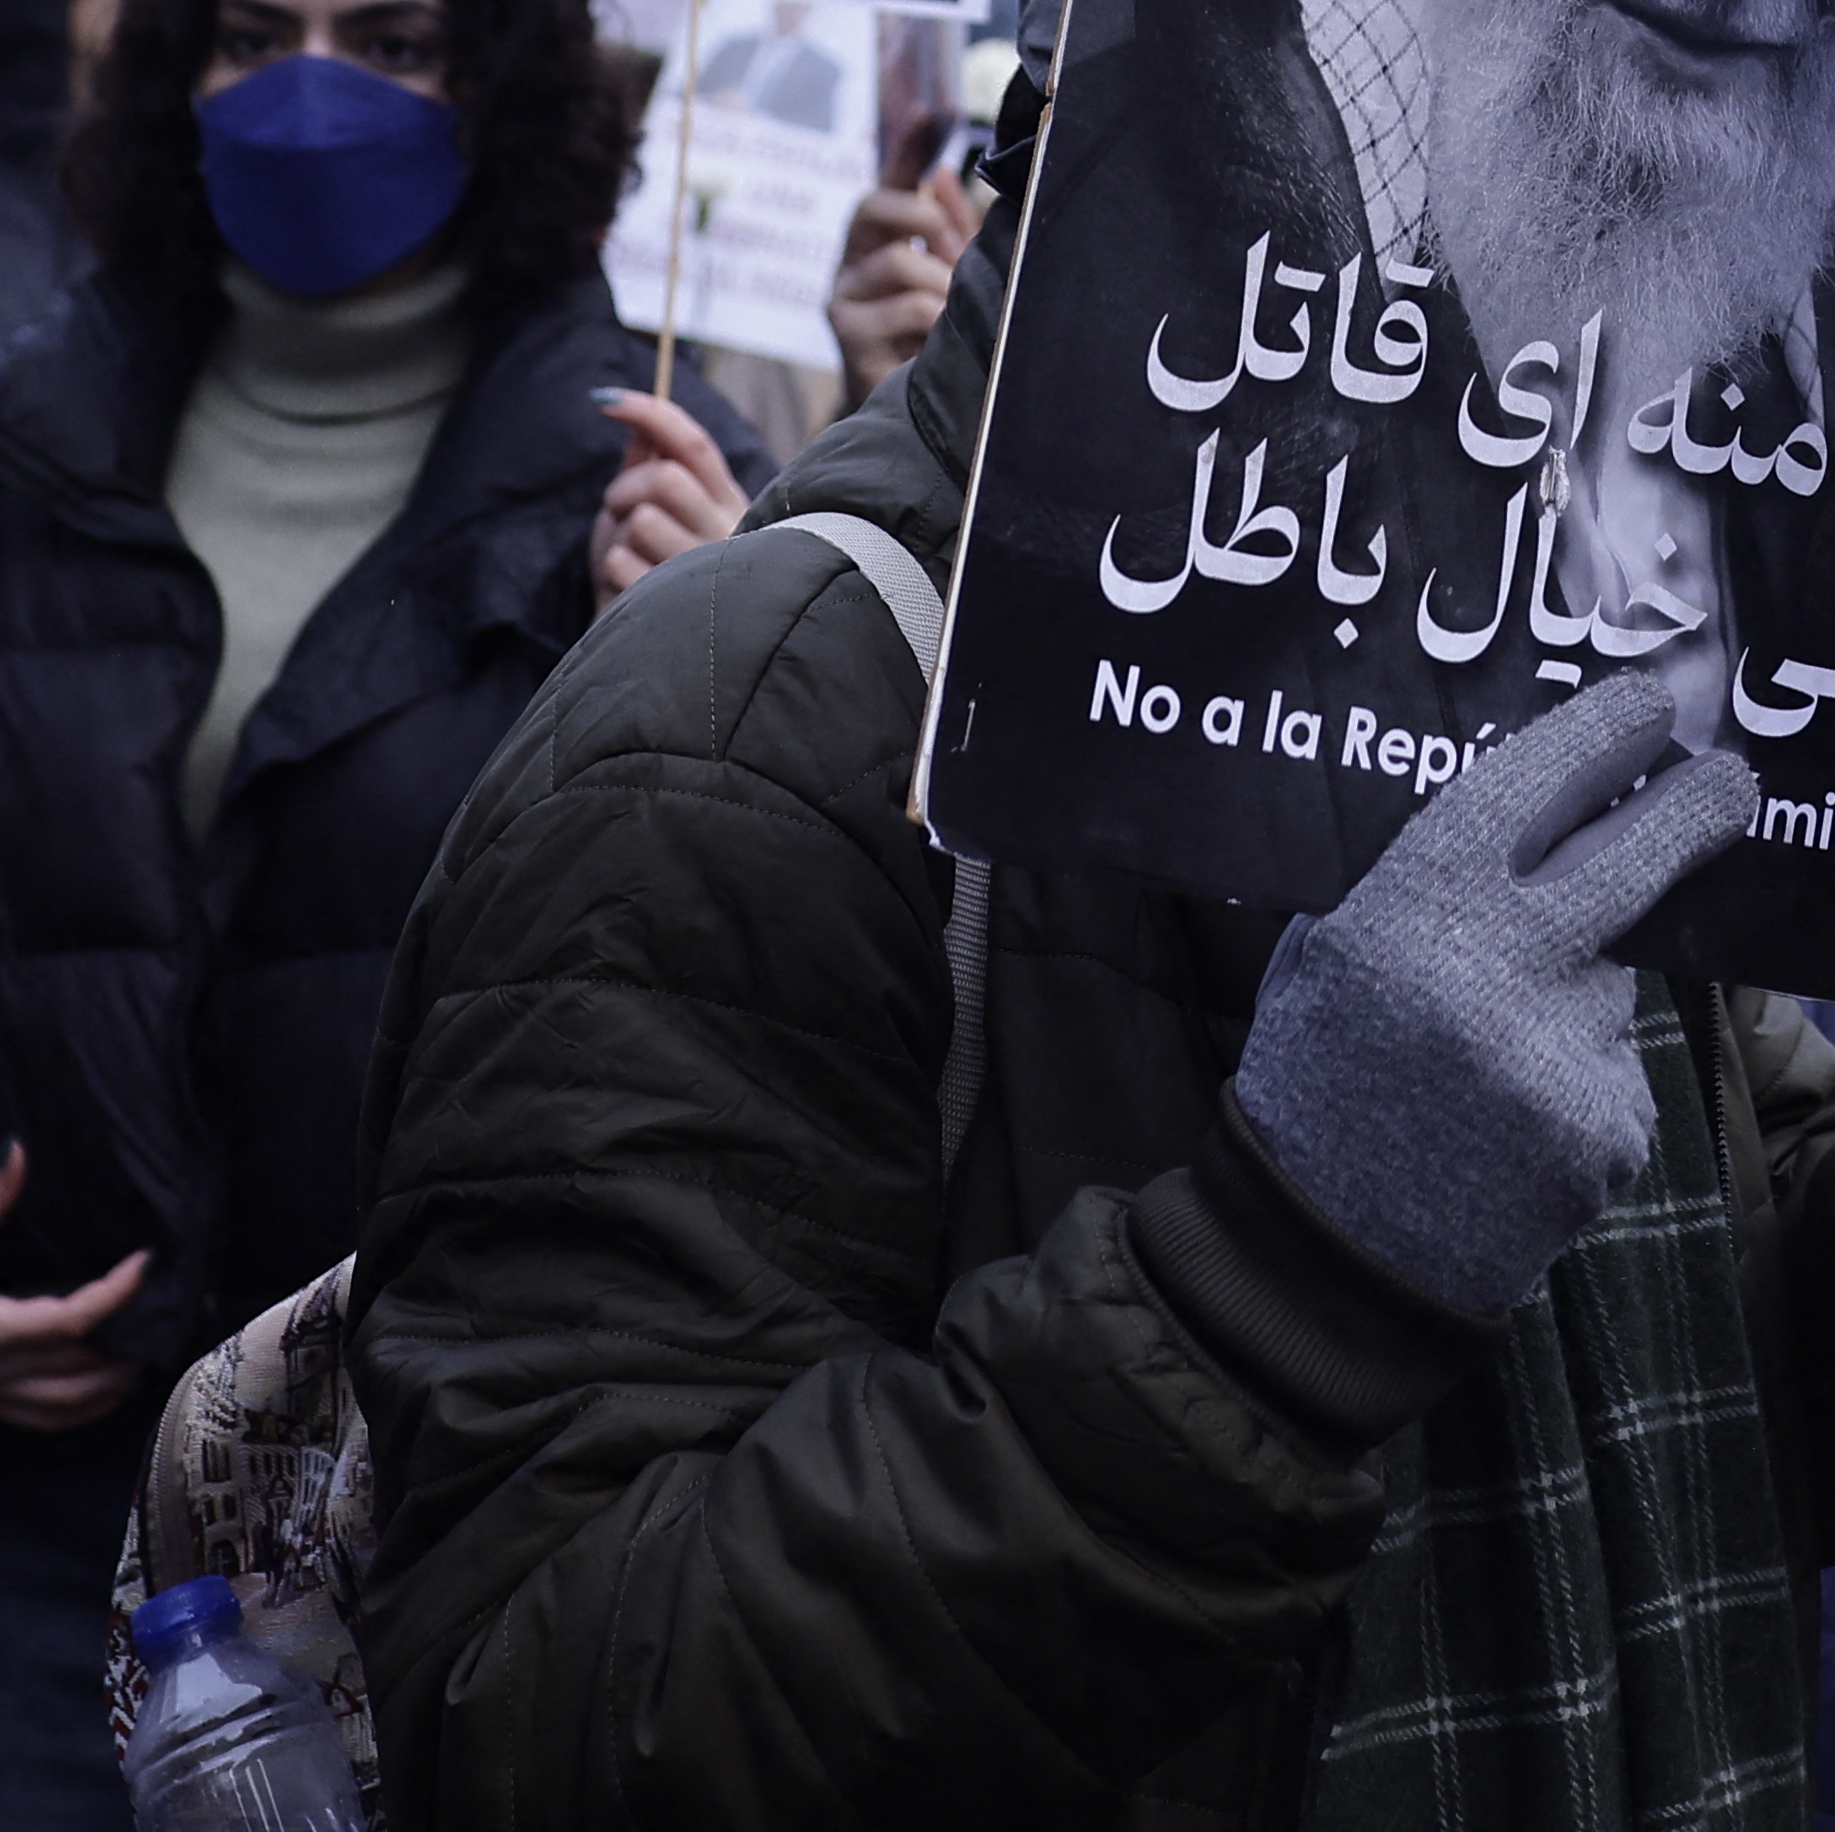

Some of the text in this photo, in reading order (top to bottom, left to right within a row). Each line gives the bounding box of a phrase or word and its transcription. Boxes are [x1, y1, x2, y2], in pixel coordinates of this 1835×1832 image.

[1146, 230, 1434, 412] قاتل
[1458, 309, 1604, 468] ای
[1098, 426, 1387, 649] باطل
[1414, 480, 1709, 686] خیال
[1089, 658, 1182, 734] No
[1202, 695, 1245, 747] a
[1261, 689, 1323, 761] la
